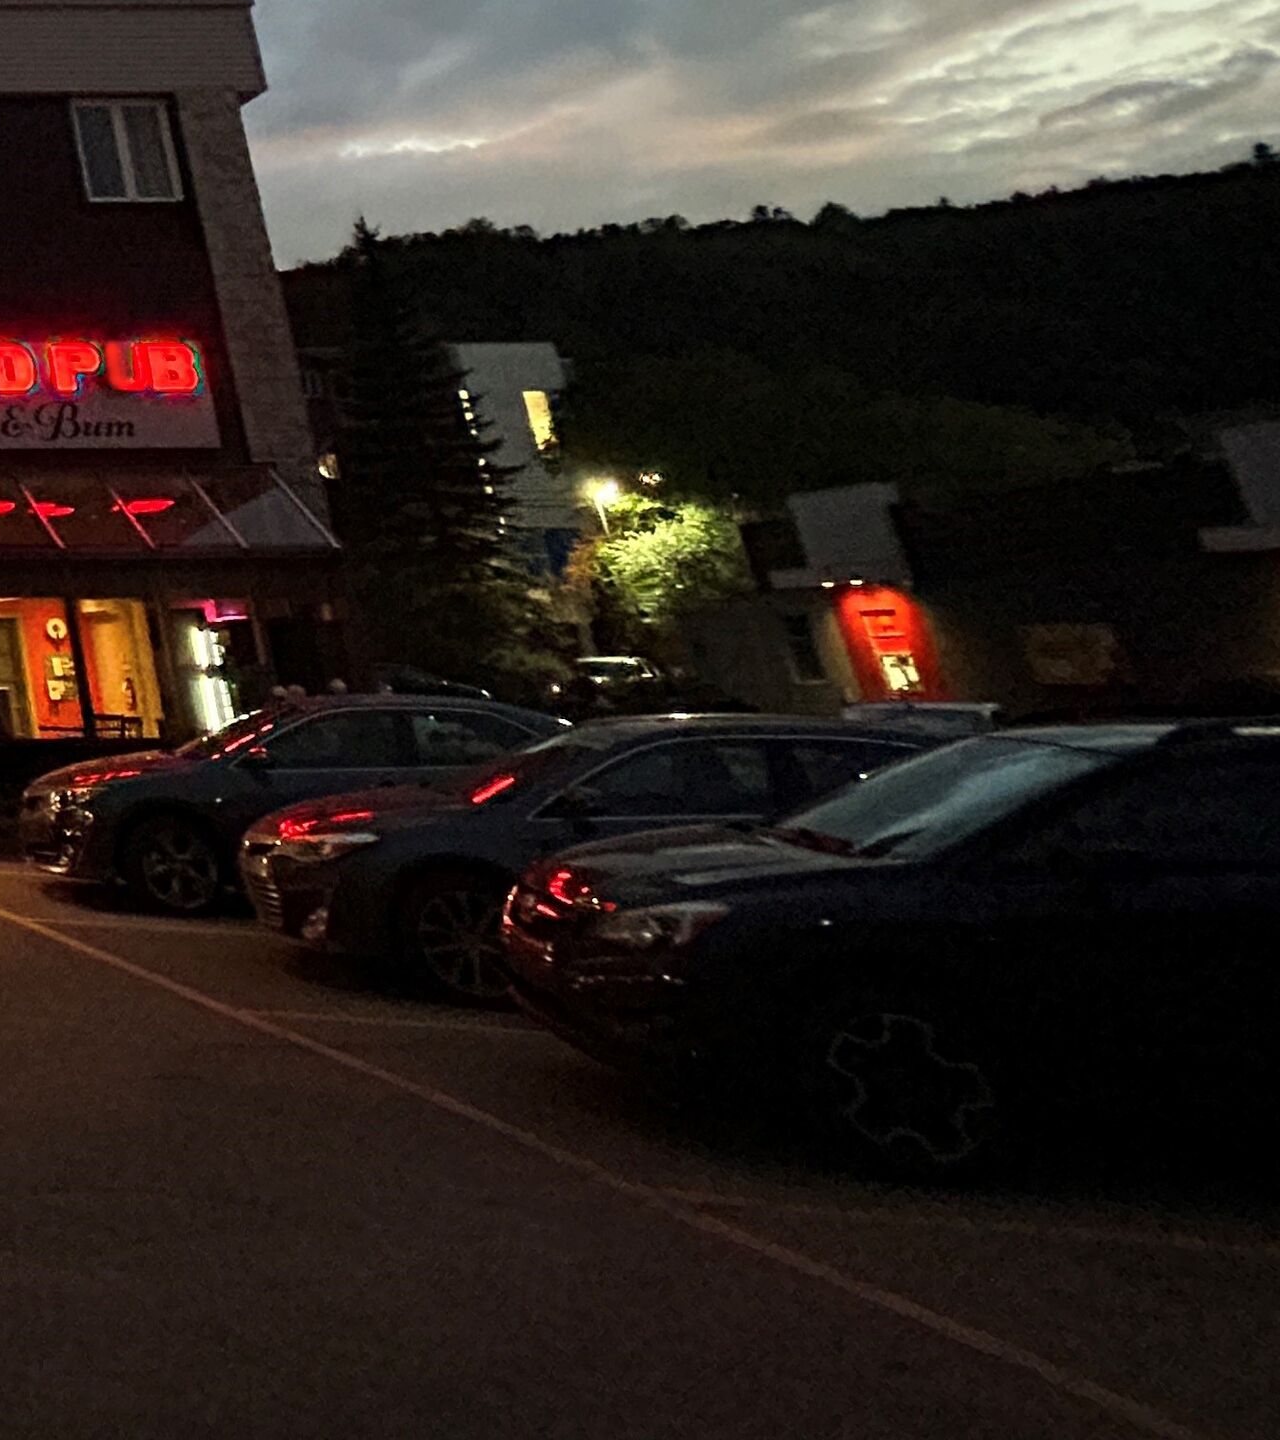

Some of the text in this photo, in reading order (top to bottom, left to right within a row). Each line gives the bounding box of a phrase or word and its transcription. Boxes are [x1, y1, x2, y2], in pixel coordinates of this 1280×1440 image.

[50, 342, 201, 394] PUB
[1, 397, 36, 438] &
[34, 399, 136, 441] Bum
